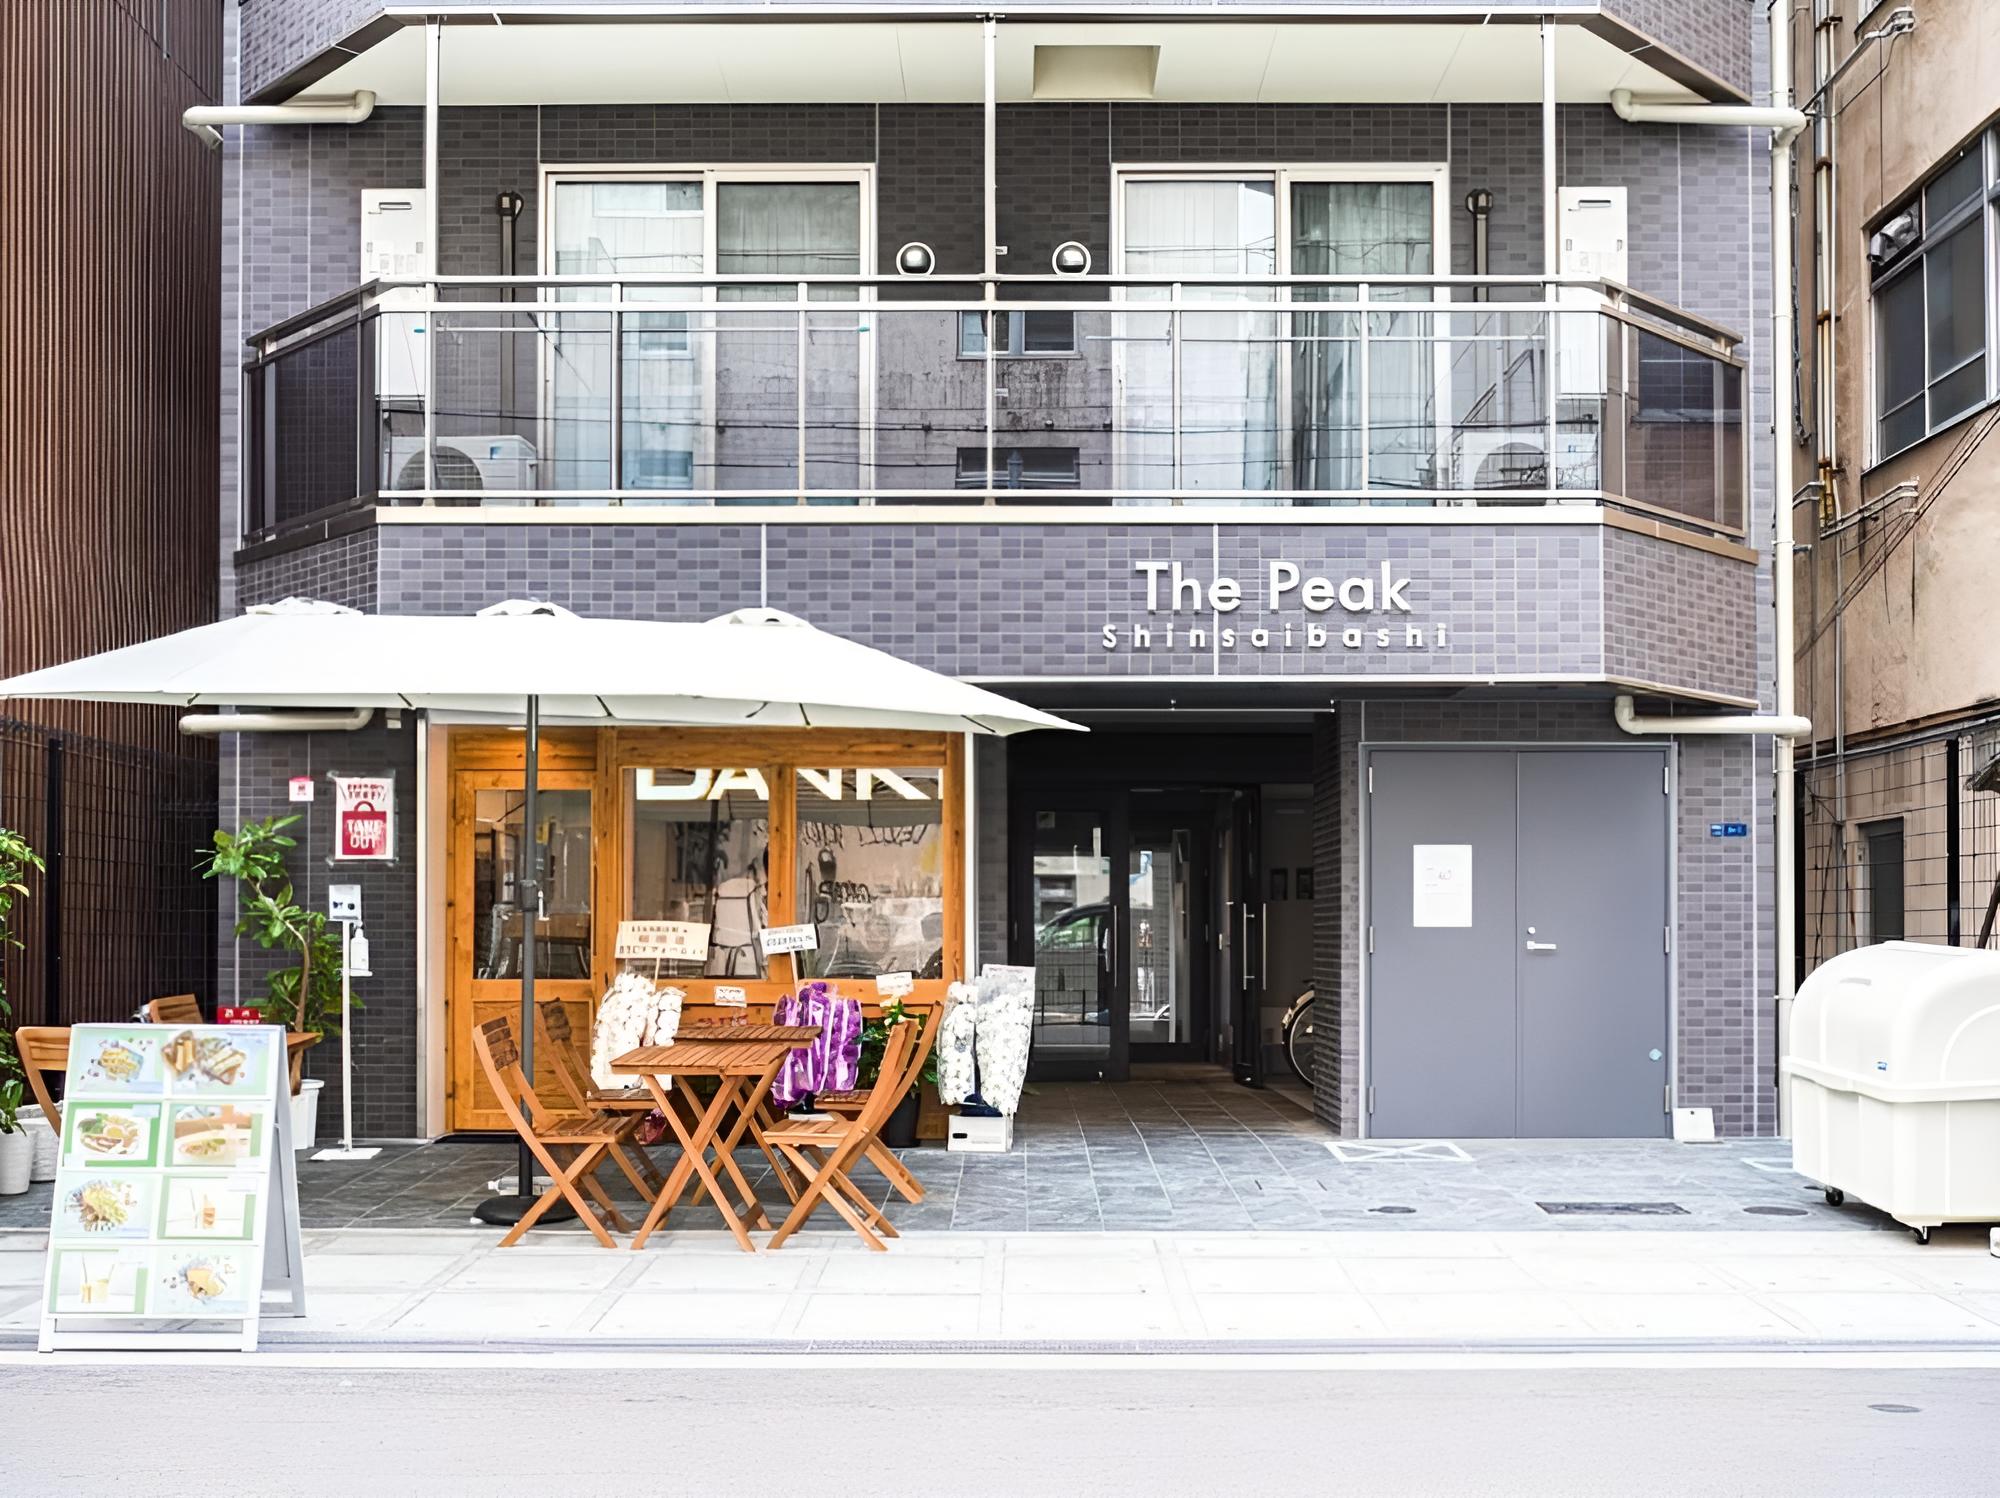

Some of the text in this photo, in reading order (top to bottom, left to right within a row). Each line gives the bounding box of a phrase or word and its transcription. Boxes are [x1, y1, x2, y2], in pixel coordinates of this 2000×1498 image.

[1136, 560, 1411, 611] The Peak
[1102, 622, 1446, 648] Shinsaibashi
